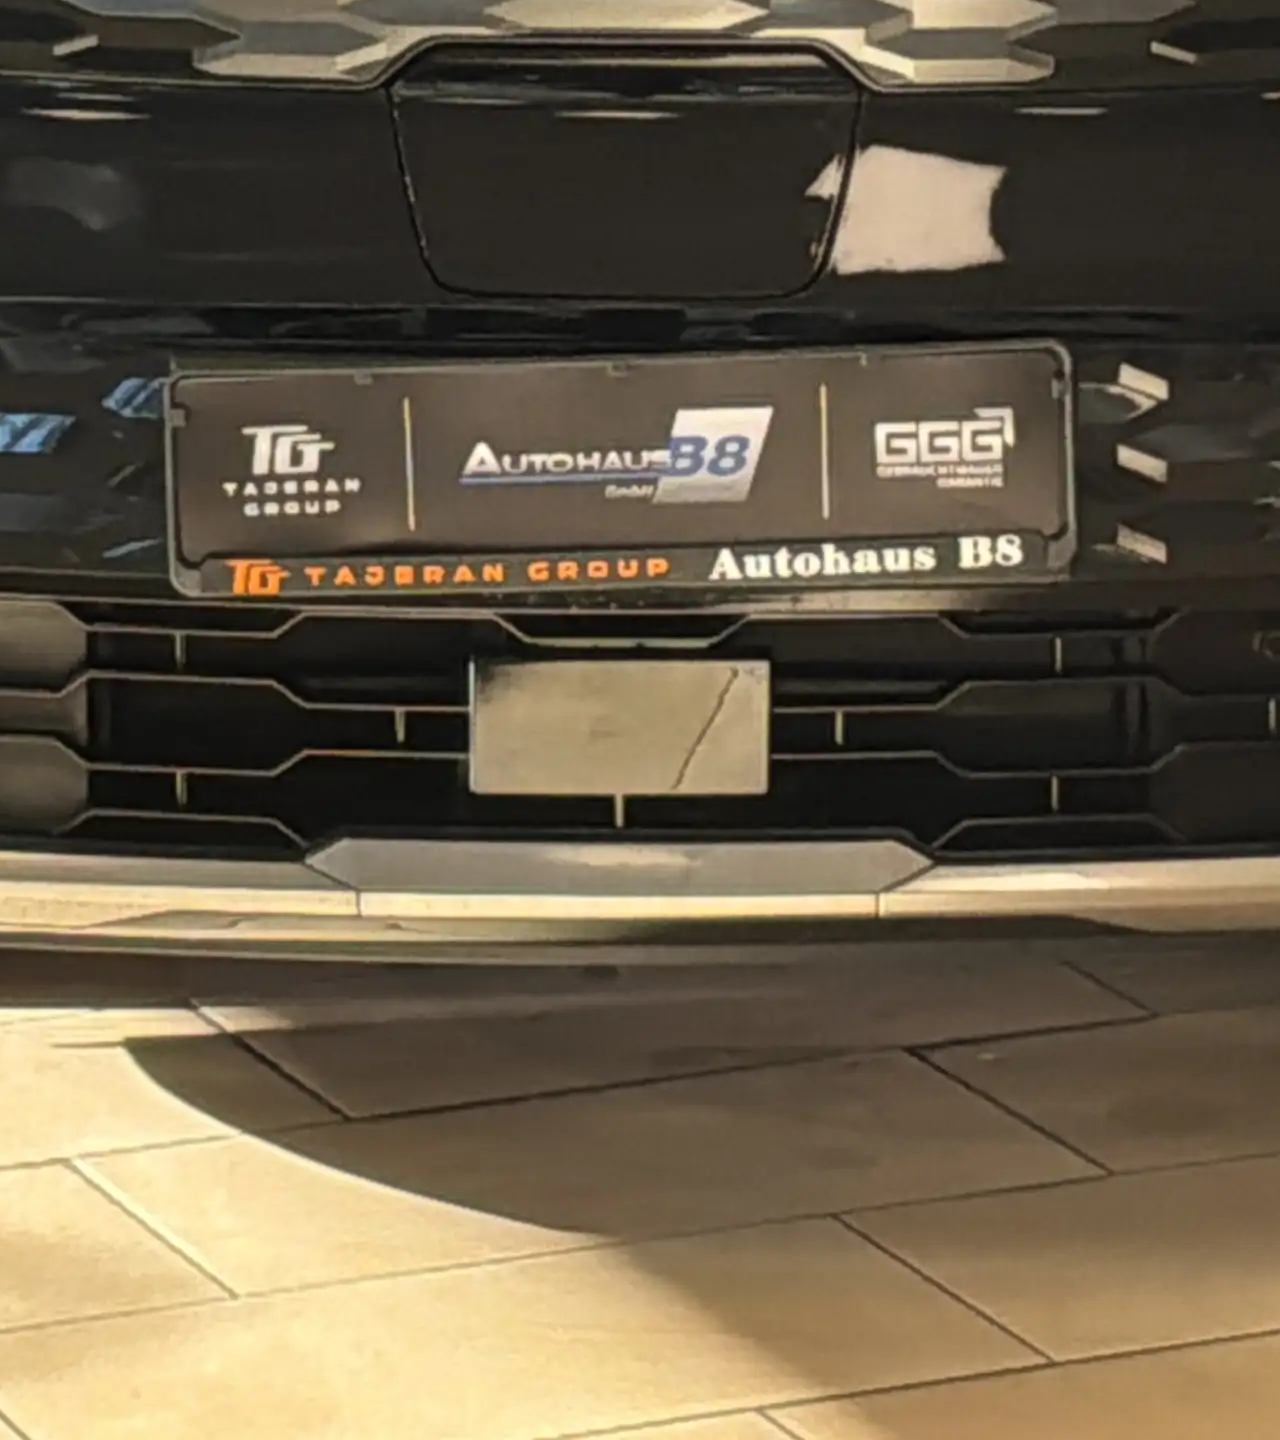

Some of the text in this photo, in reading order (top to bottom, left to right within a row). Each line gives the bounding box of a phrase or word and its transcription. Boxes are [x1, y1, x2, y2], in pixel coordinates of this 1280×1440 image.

[241, 424, 336, 476] TG
[874, 420, 1004, 463] GGG
[242, 498, 342, 518] GROUP
[303, 562, 505, 588] TAJERAN
[526, 557, 671, 582] GROUP
[707, 533, 1024, 581] Autohaus B8
